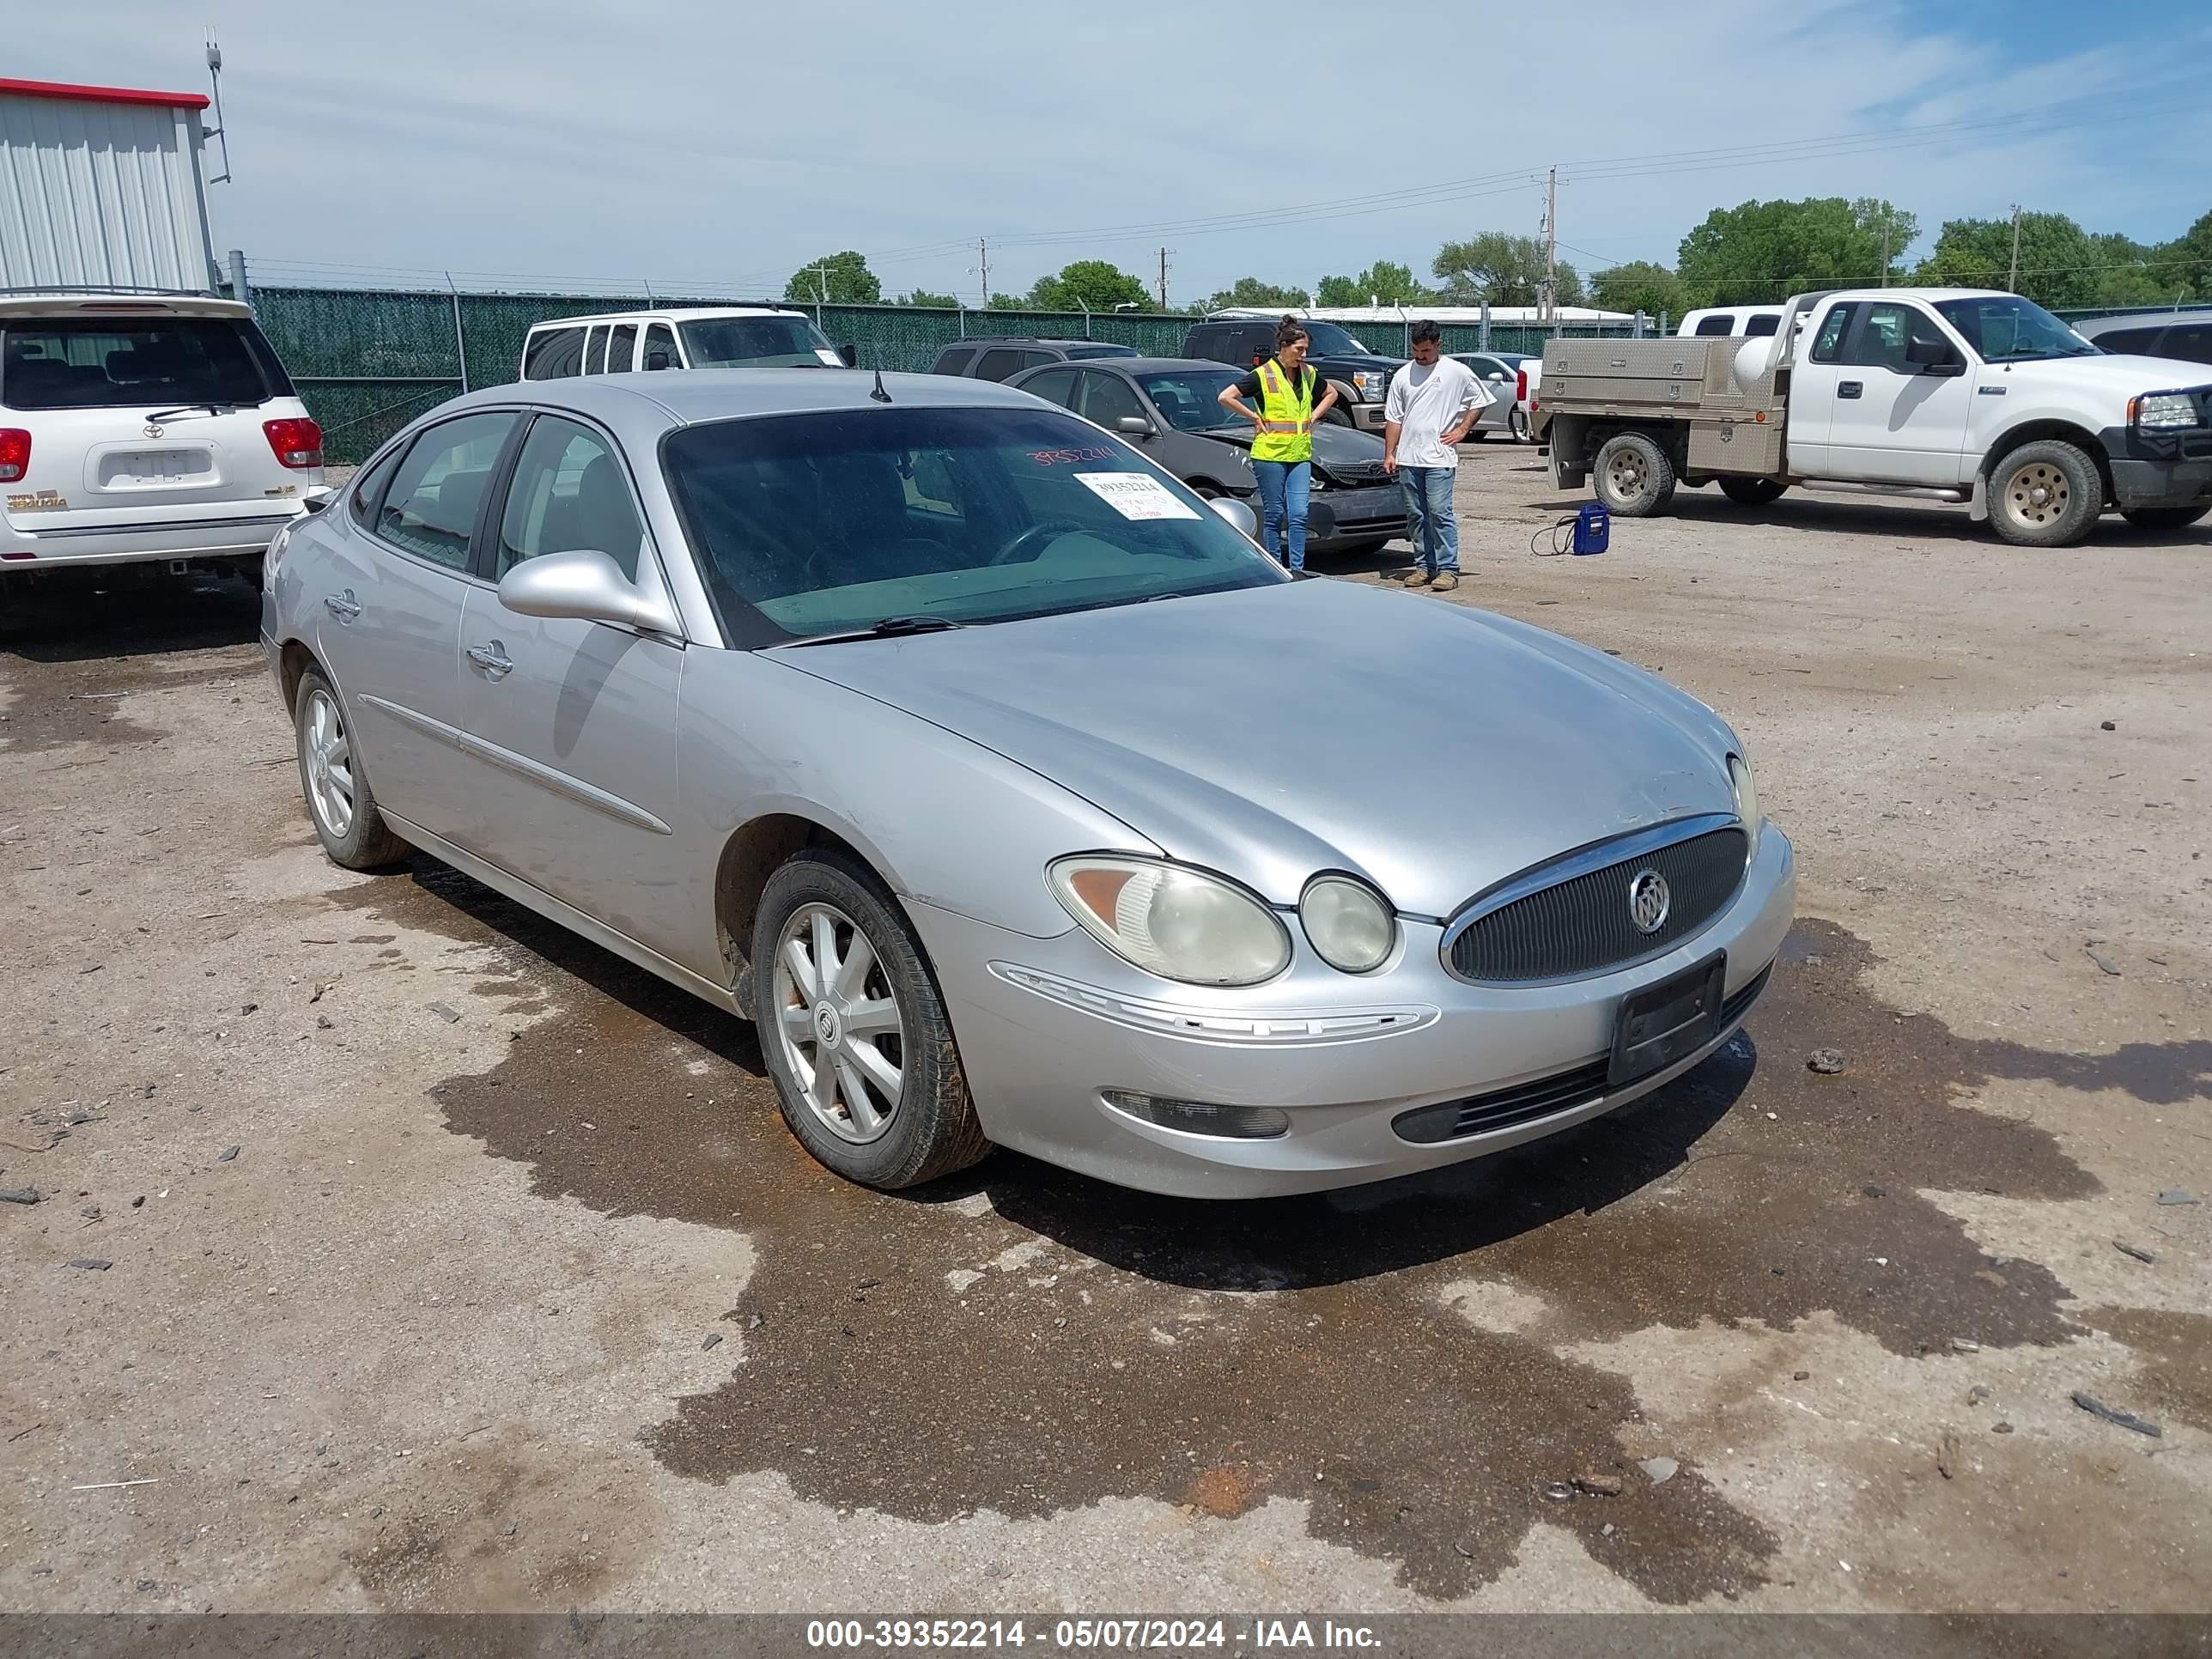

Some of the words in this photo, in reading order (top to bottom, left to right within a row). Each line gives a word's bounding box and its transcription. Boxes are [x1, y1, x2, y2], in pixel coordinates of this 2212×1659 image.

[1026, 446, 1123, 466] 39352214
[1096, 482, 1159, 493] 39352214
[6, 498, 68, 509] SEQUOIA
